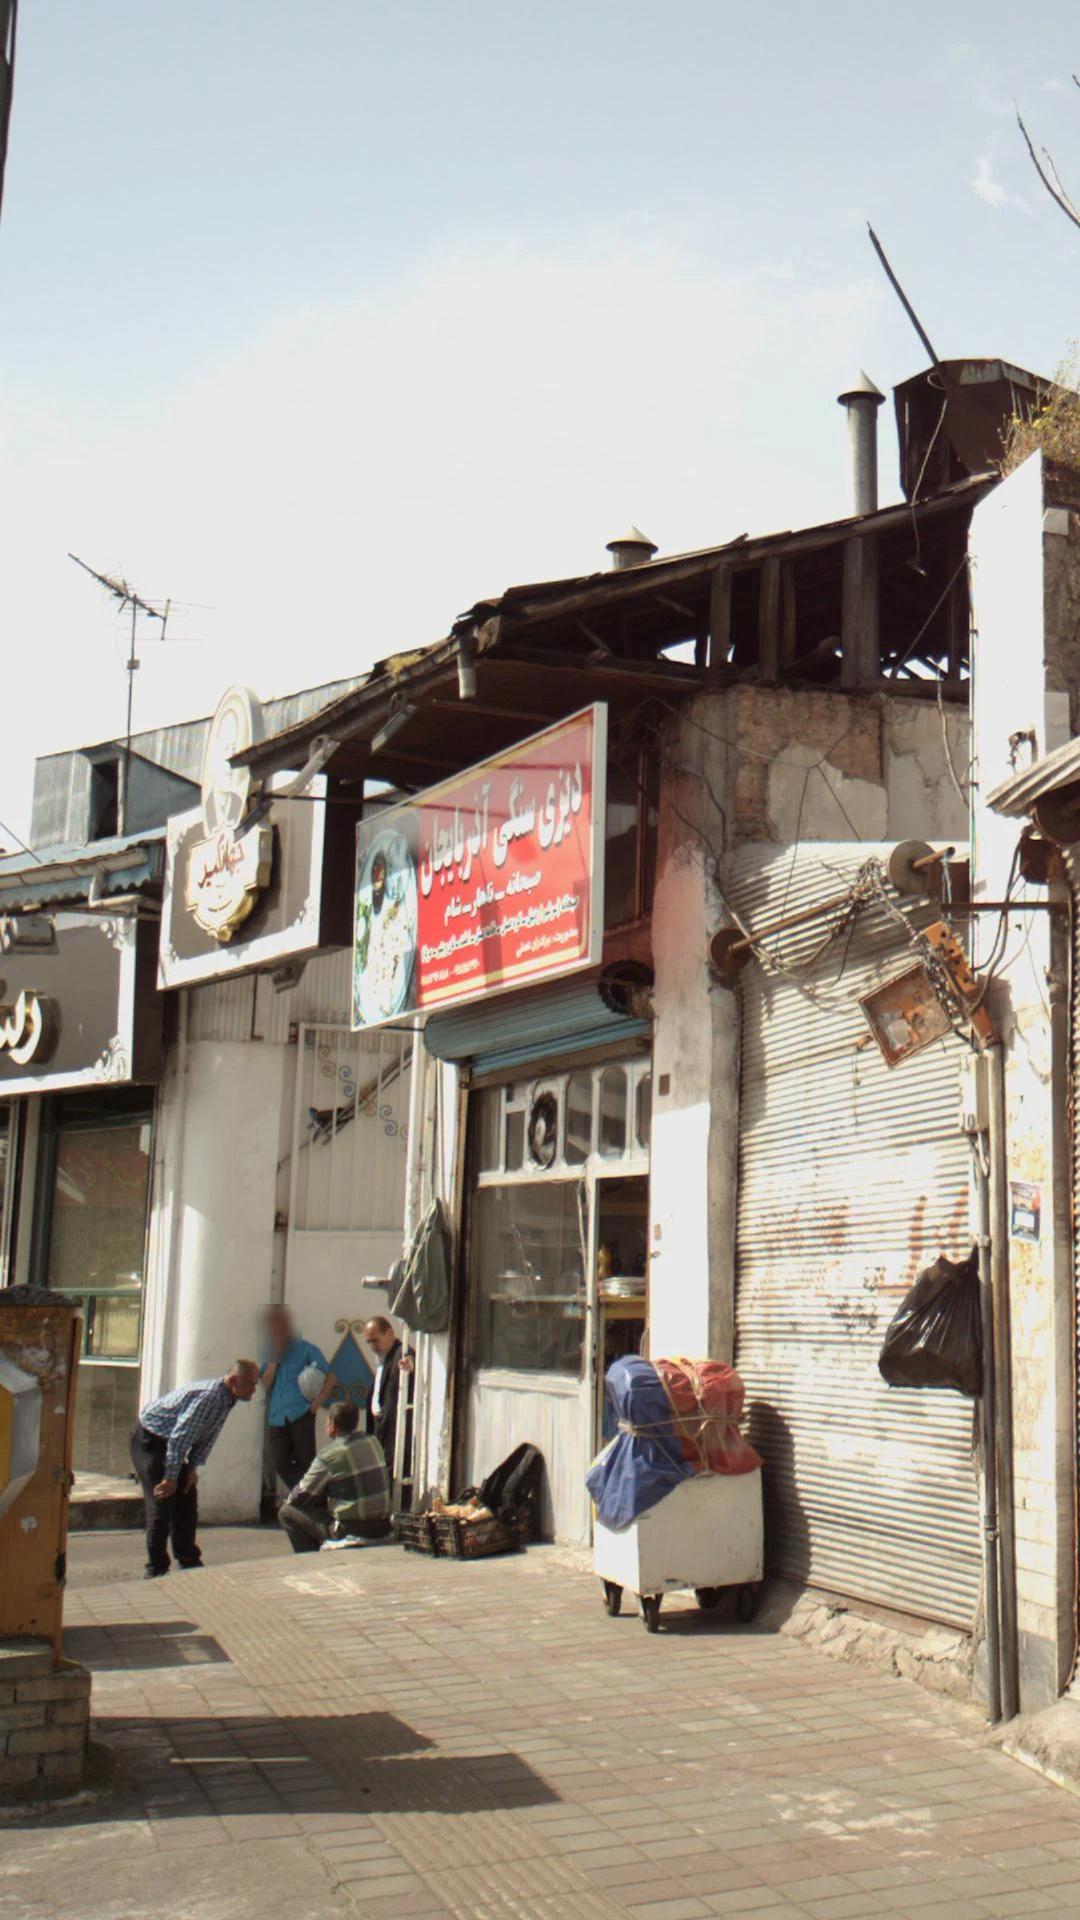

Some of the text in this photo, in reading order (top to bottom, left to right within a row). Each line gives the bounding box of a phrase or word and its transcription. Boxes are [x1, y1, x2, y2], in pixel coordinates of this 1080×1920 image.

[421, 761, 582, 896] دیزی سنگی آذربایجان
[506, 870, 541, 895] صبحانه
[444, 896, 462, 926] شام
